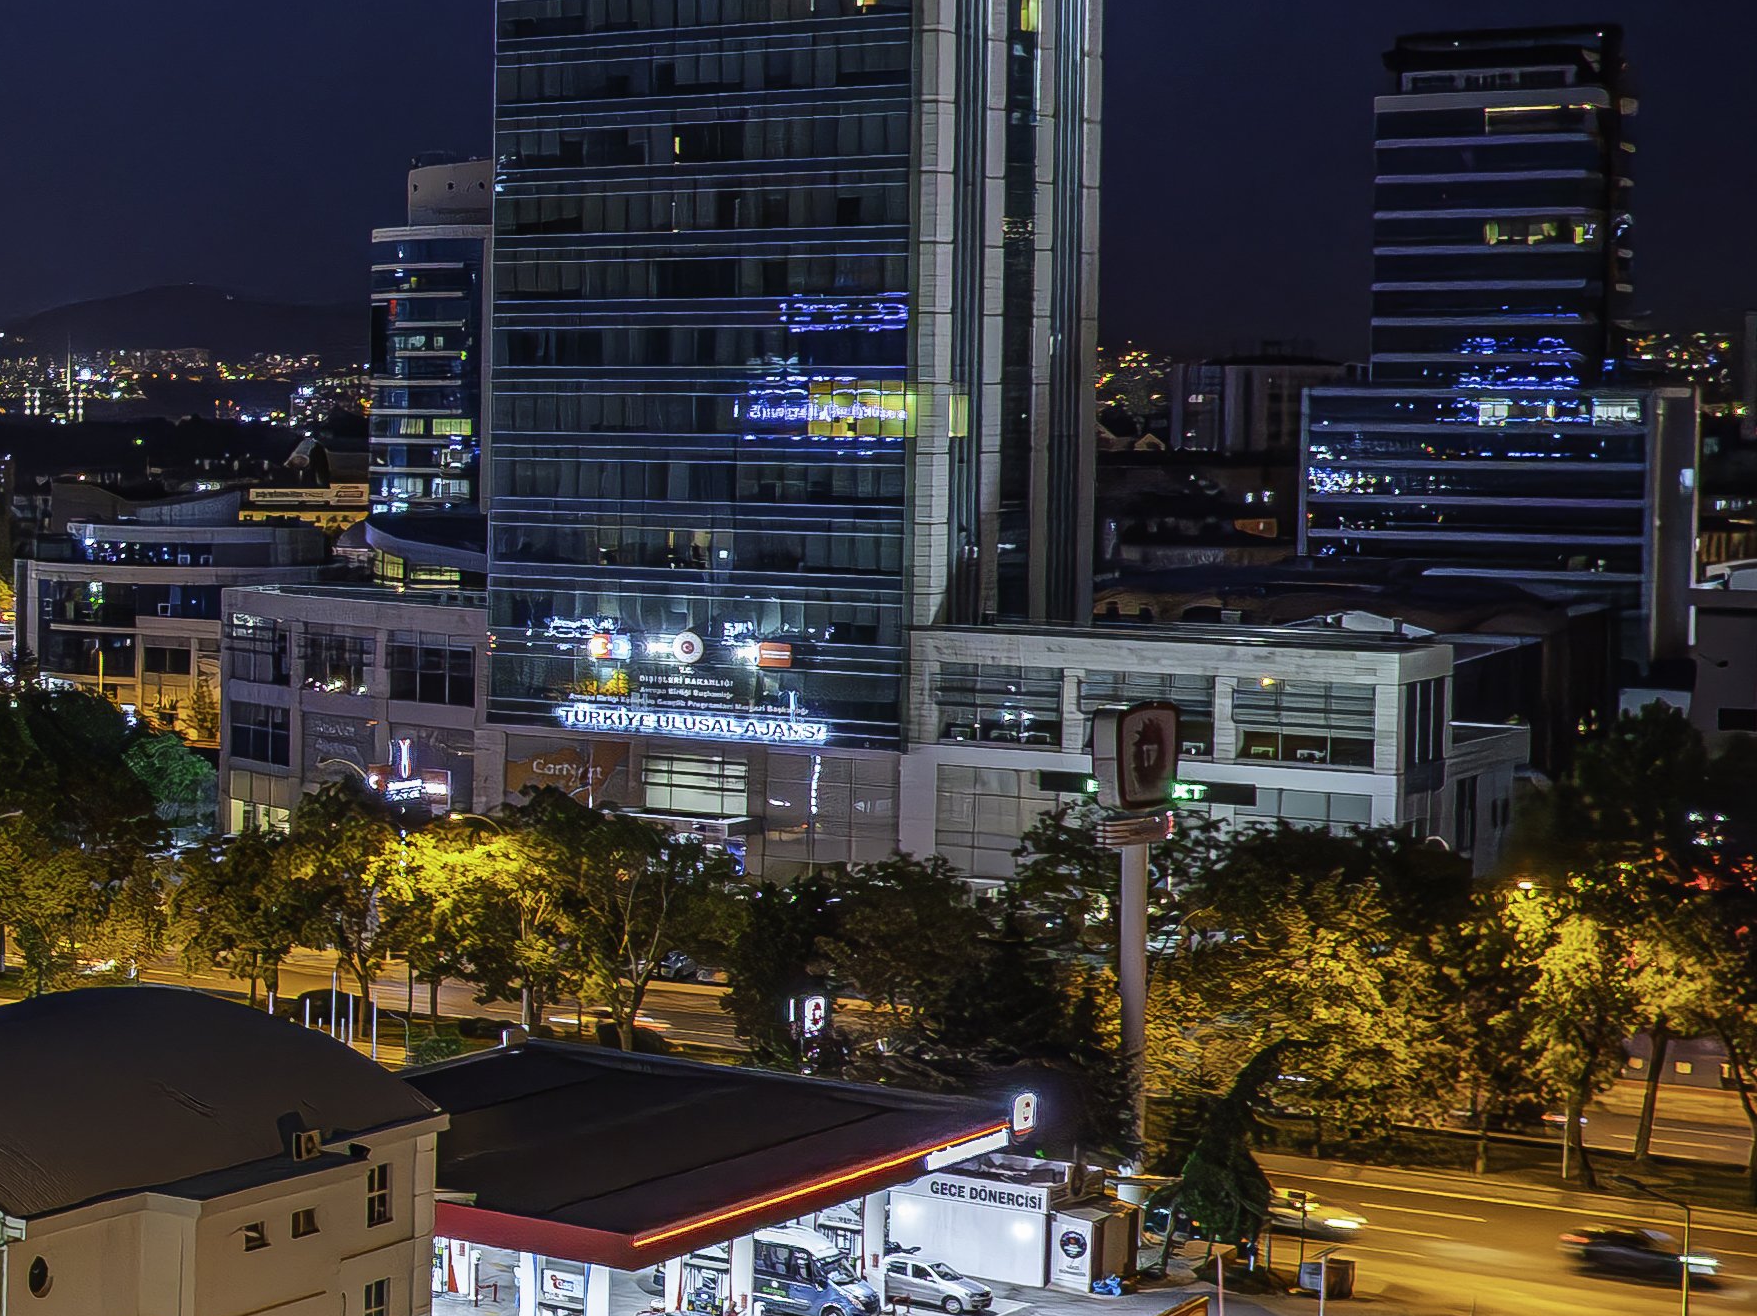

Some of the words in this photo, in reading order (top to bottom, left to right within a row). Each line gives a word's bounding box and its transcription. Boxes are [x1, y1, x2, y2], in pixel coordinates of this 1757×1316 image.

[561, 704, 653, 727] TÜRKİYE
[656, 714, 738, 733] ULUSAL
[930, 1181, 966, 1198] GECE
[969, 1185, 1042, 1210] DÖNERCİSİ
